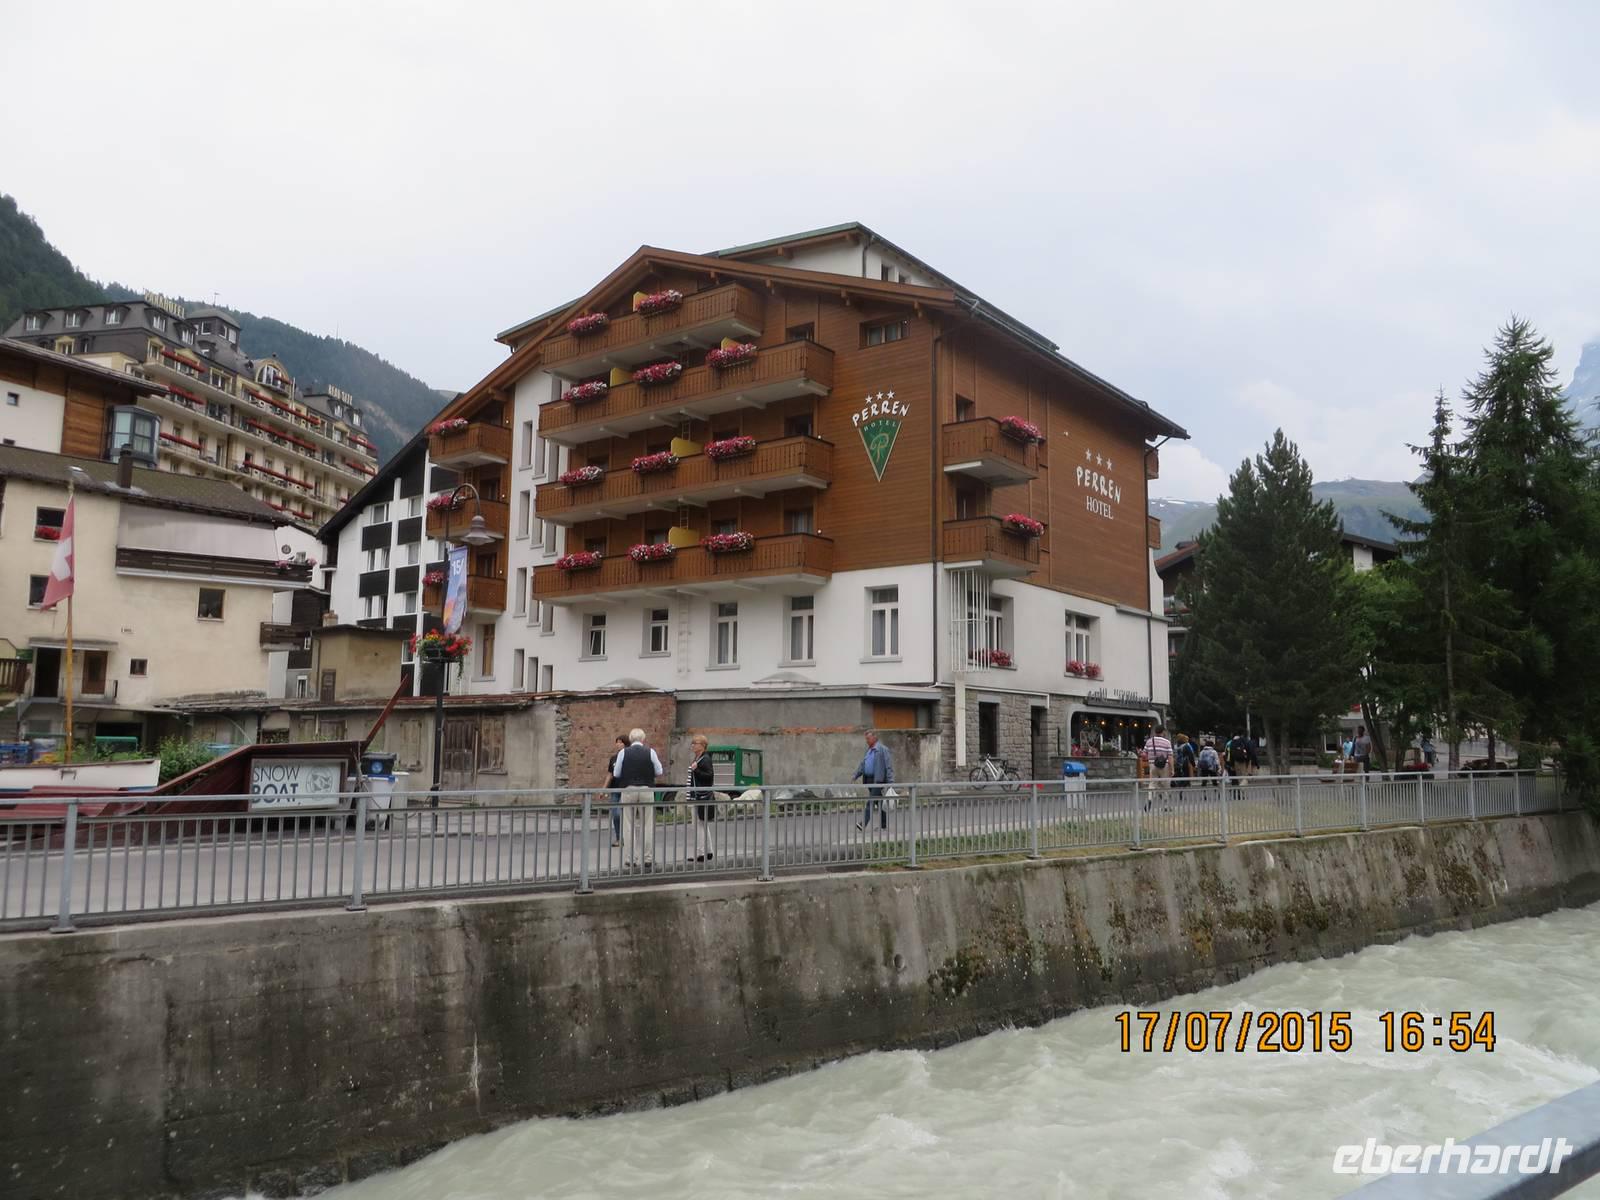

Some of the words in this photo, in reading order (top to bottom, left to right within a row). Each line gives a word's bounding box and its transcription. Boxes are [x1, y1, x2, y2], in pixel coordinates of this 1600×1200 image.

[852, 400, 910, 427] PERREN
[863, 419, 897, 432] HOTEL
[1076, 465, 1122, 505] PERREN
[1086, 495, 1114, 520] HOTEL
[252, 764, 300, 783] SNOW
